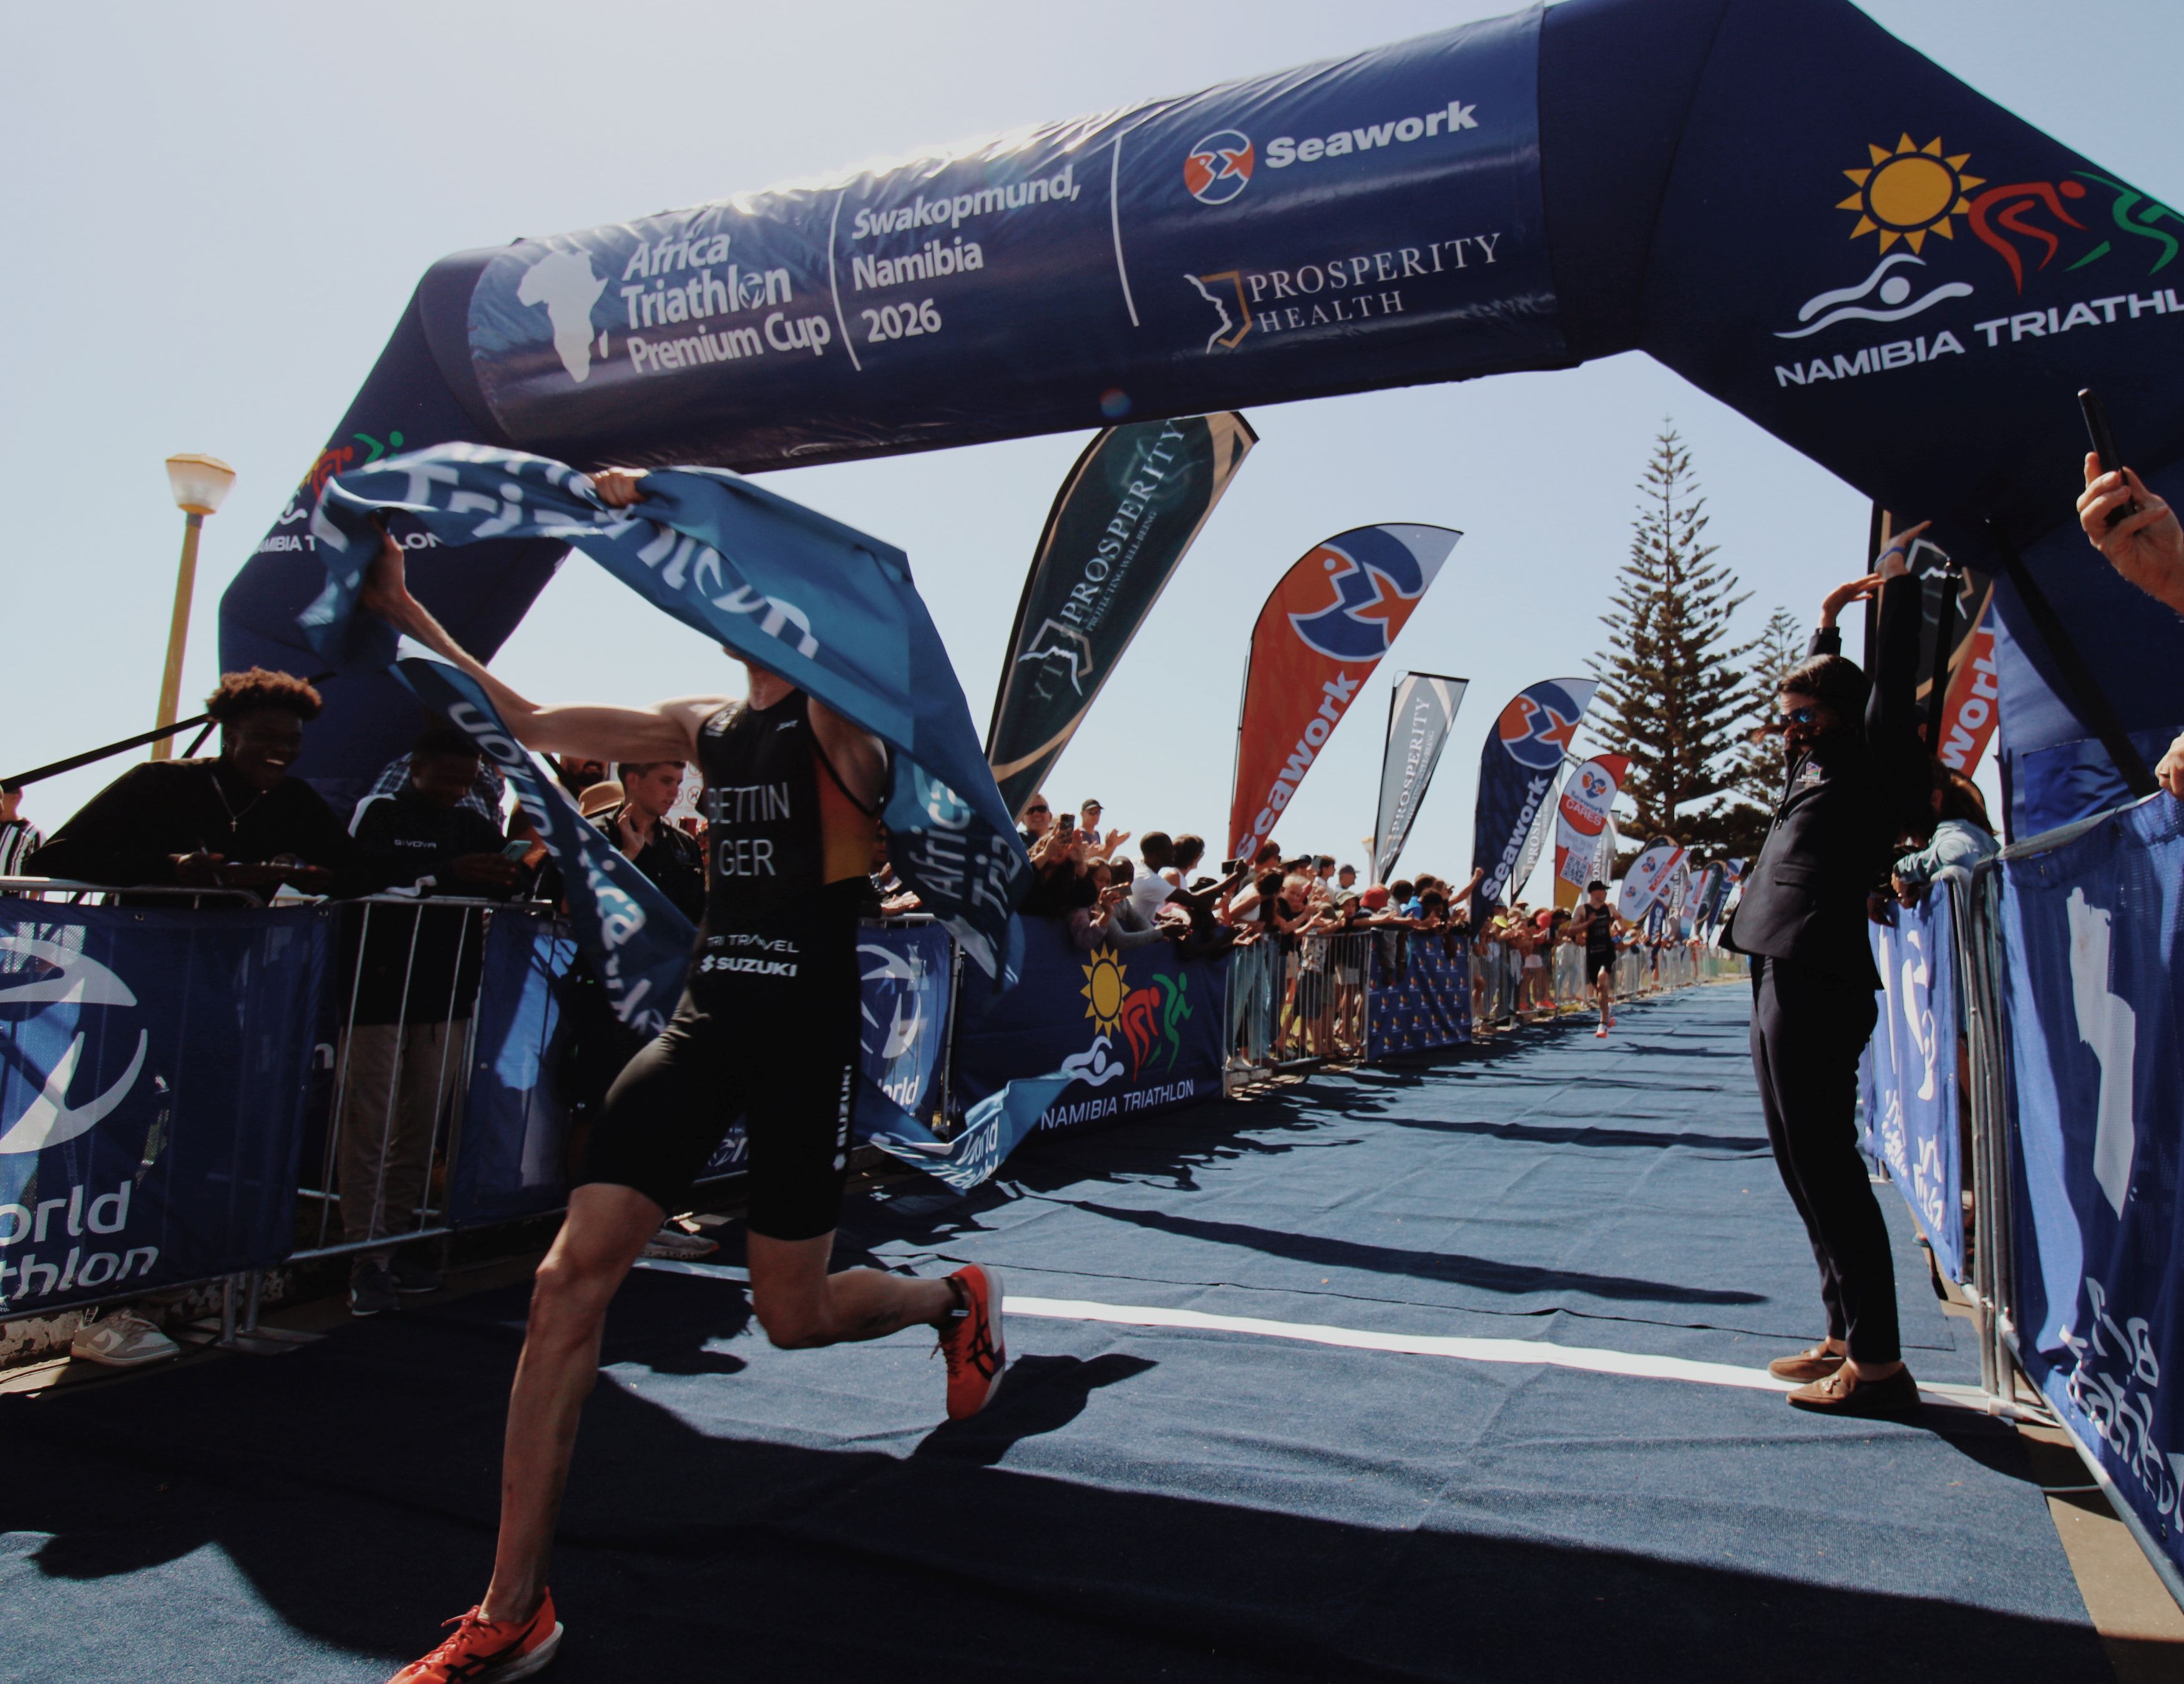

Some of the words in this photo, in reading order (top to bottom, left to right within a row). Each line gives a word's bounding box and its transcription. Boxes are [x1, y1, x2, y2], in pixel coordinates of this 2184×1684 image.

[1265, 100, 1478, 168] Seawork
[852, 165, 1082, 241] Swakopmund,
[622, 233, 731, 282] Africa
[852, 241, 984, 292] Namibia
[1248, 232, 1501, 303] PROSPERITY
[620, 266, 792, 329] Triathlon
[860, 298, 943, 344] 2026
[1255, 290, 1405, 333] HEALTH
[627, 324, 763, 374] Premium
[764, 311, 831, 356] Cup
[1774, 330, 1966, 387] NAMIBIA
[1974, 288, 2184, 348] TRIATHL
[256, 534, 303, 553] AMIBIA
[1060, 419, 1185, 628] PROSPERITY
[1085, 567, 1126, 633] PROTECTING
[1941, 646, 1998, 770] work
[1236, 670, 1360, 860] Seawork
[1392, 697, 1430, 833] PROSPERITY
[708, 782, 791, 824] BETTIN
[1566, 798, 1603, 827] CARES
[718, 839, 776, 876] GER
[1481, 775, 1549, 902] Seawork
[716, 956, 798, 977] SUZUKI
[728, 934, 800, 953] TRAVEL
[877, 1075, 920, 1106] orld
[1040, 1096, 1118, 1131] NAMIBIA
[1123, 1079, 1194, 1113] TRIATHLON
[0, 1180, 132, 1247] orld
[0, 1245, 160, 1302] thlon
